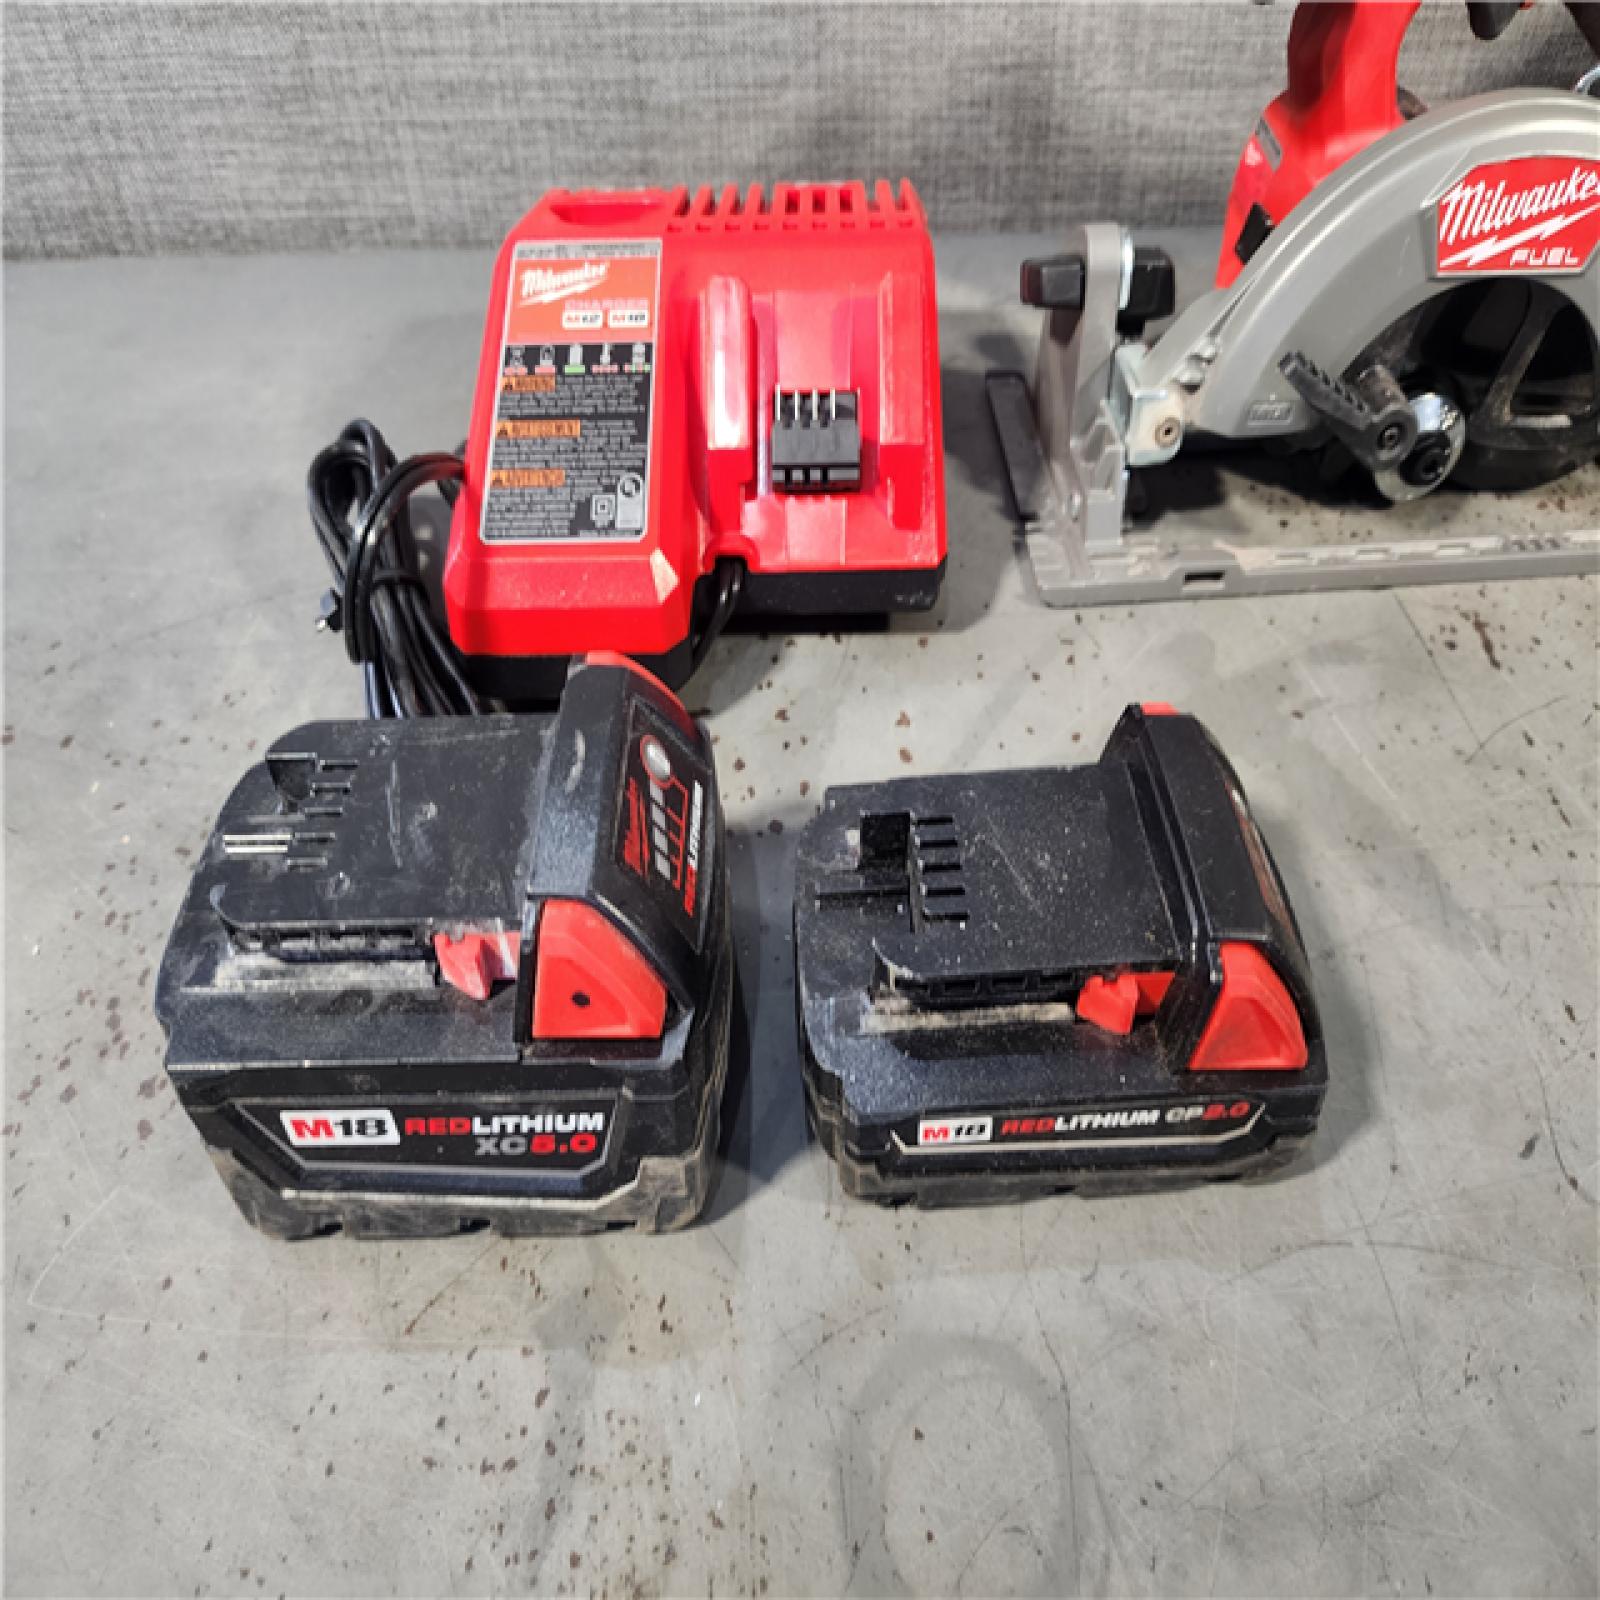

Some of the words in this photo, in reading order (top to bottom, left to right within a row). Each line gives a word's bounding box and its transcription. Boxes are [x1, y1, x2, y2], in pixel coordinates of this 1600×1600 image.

[1439, 166, 1600, 246] Milwaukee
[1509, 247, 1579, 267] FUEL
[289, 1117, 389, 1139] M18
[404, 1111, 605, 1136] REDLITHIUM
[922, 1121, 988, 1142] M18
[1000, 1108, 1161, 1136] REDLITHIUM
[474, 1132, 597, 1156] XC5.0
